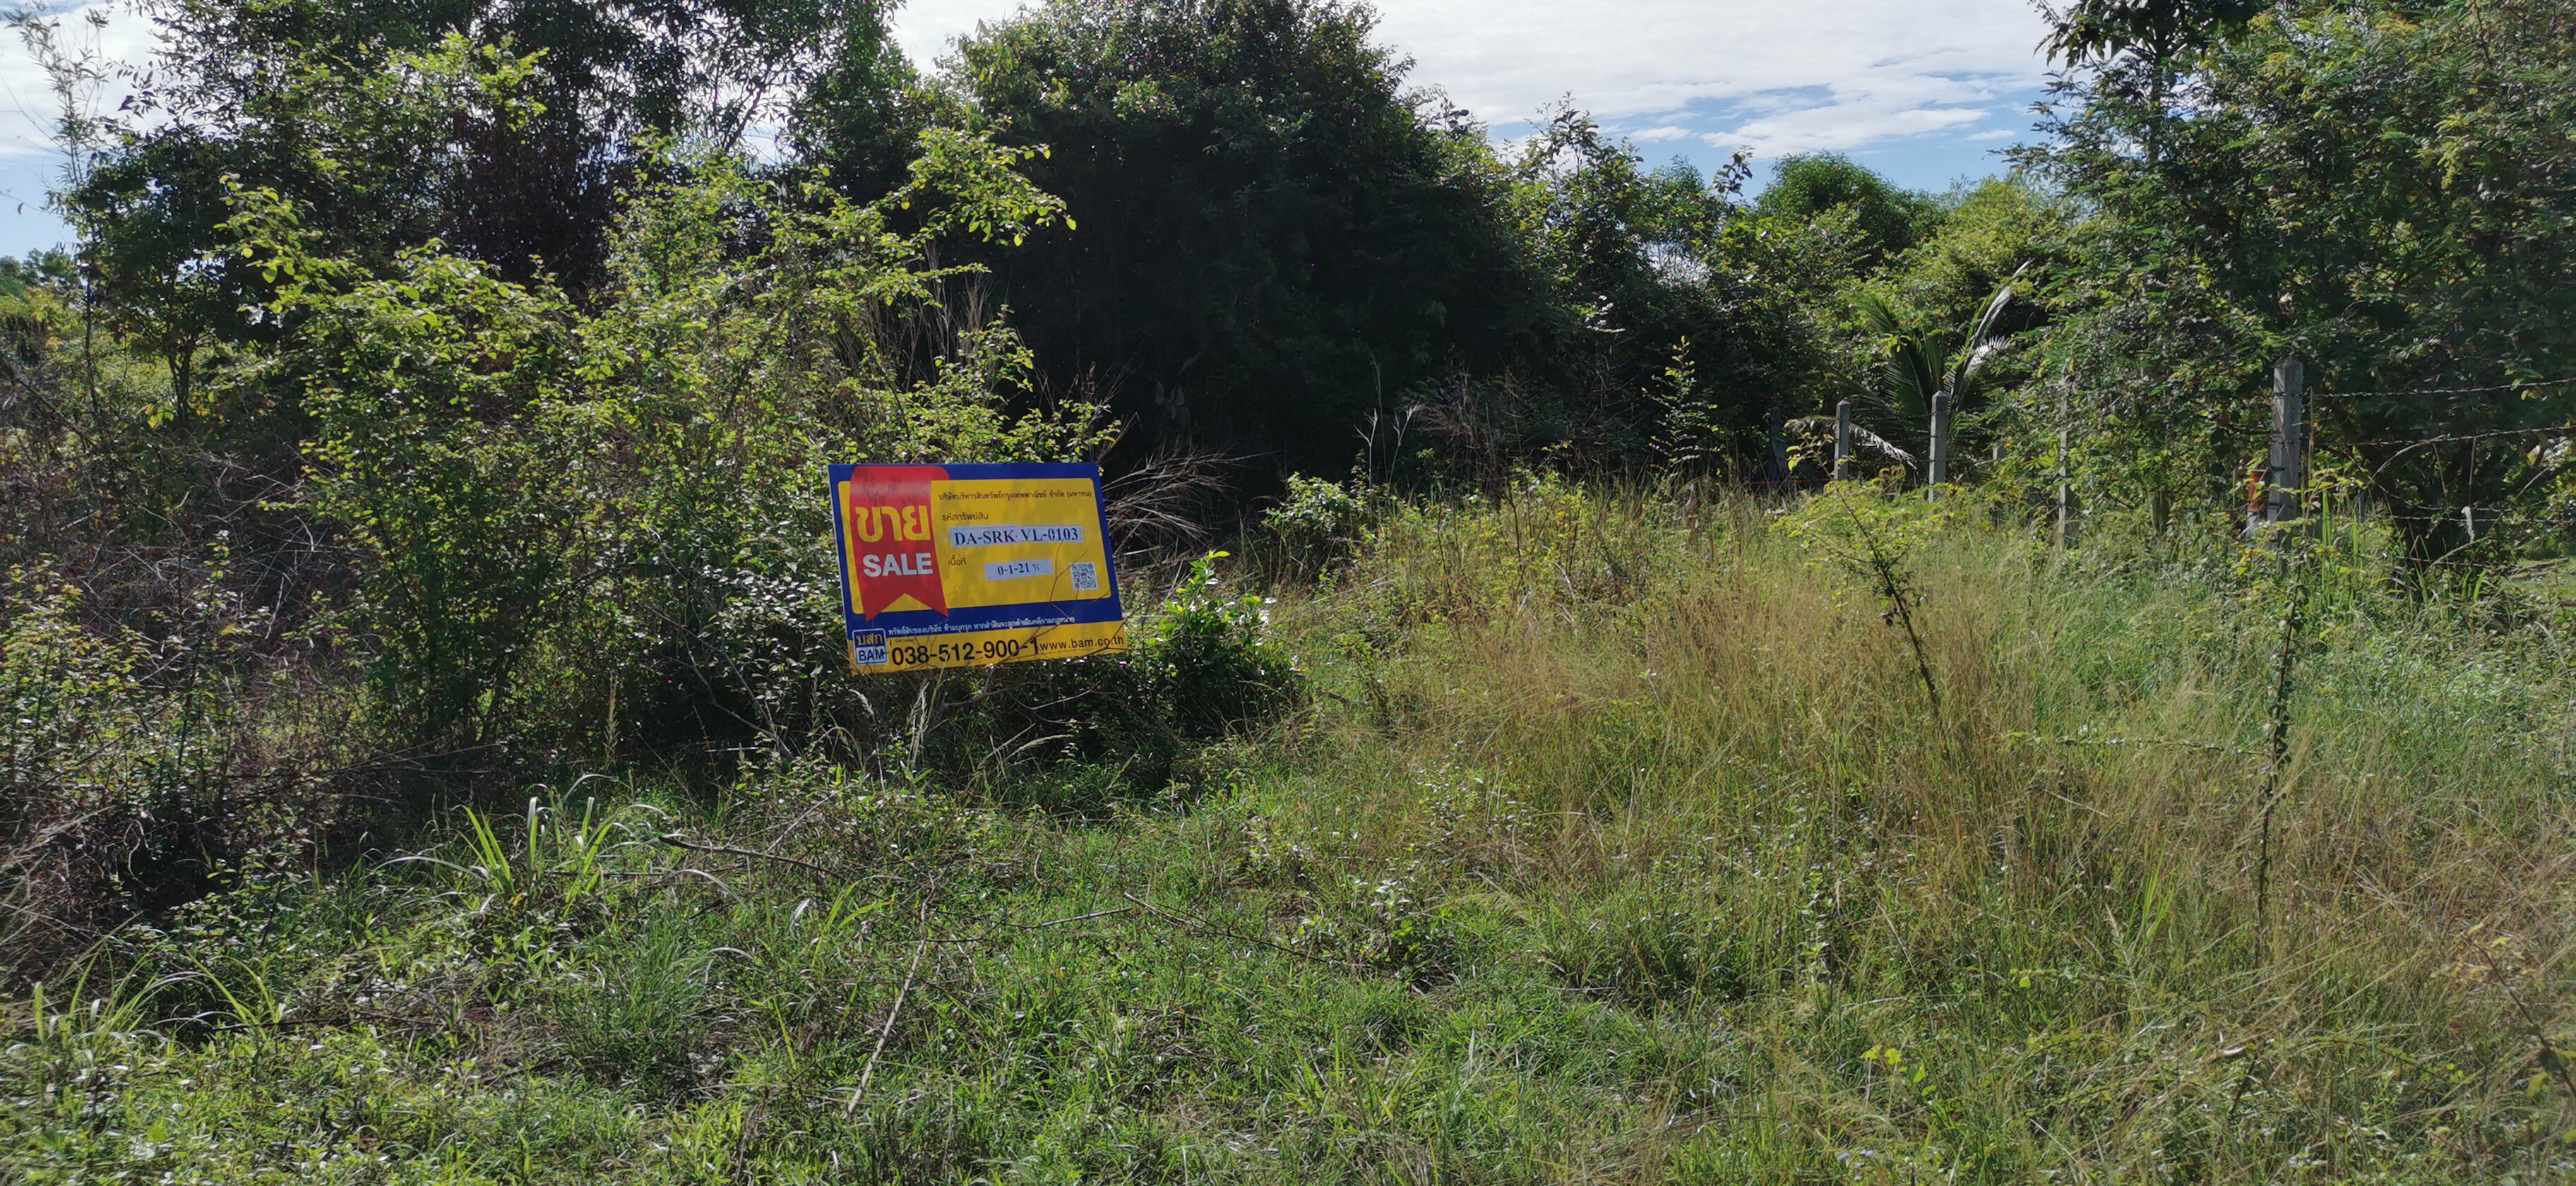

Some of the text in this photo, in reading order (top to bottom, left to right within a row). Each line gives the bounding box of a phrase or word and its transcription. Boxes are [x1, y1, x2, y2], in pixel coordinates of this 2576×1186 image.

[1049, 489, 1065, 498] จำกัด
[942, 511, 989, 521] รหัสทรัพย์สิน
[855, 505, 931, 542] ขาย
[863, 553, 934, 577] SALE
[948, 554, 967, 566] เนื้อที่
[997, 562, 1030, 576] 0-1-21
[1039, 635, 1124, 651] www.bam.co.th
[859, 649, 886, 661] BAM
[892, 637, 1039, 666] 038-512-900-1
